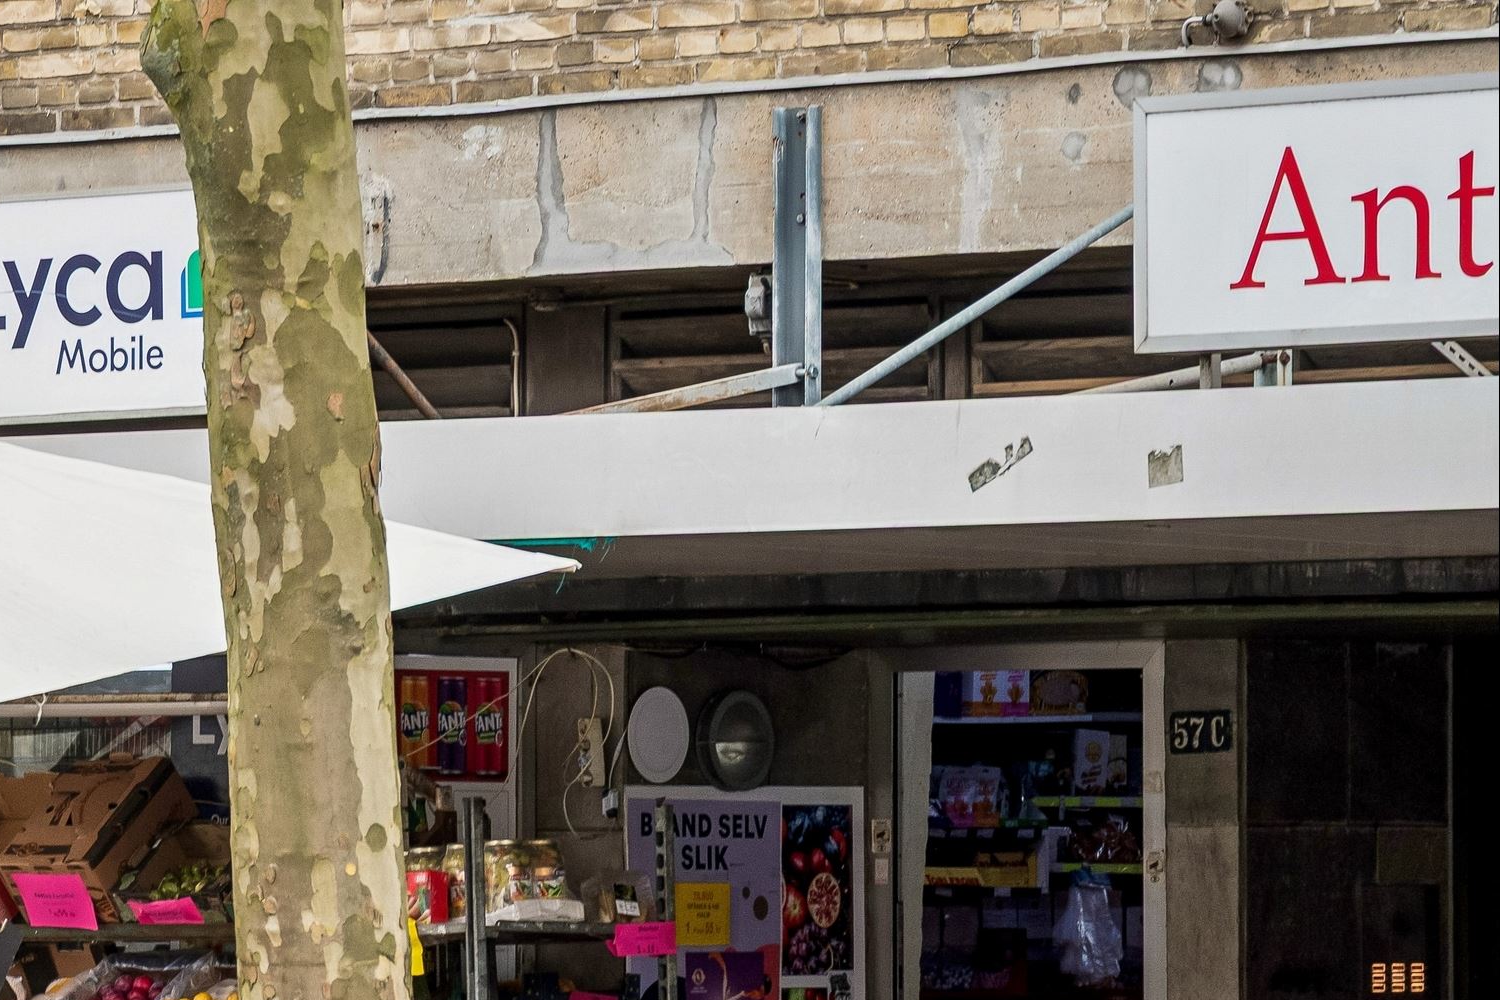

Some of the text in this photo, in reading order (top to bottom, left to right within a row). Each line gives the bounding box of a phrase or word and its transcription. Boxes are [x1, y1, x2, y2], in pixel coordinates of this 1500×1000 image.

[1230, 146, 1495, 291] Ant
[56, 334, 164, 376] Mobile
[718, 813, 768, 839] SELV
[681, 844, 729, 870] SLIK
